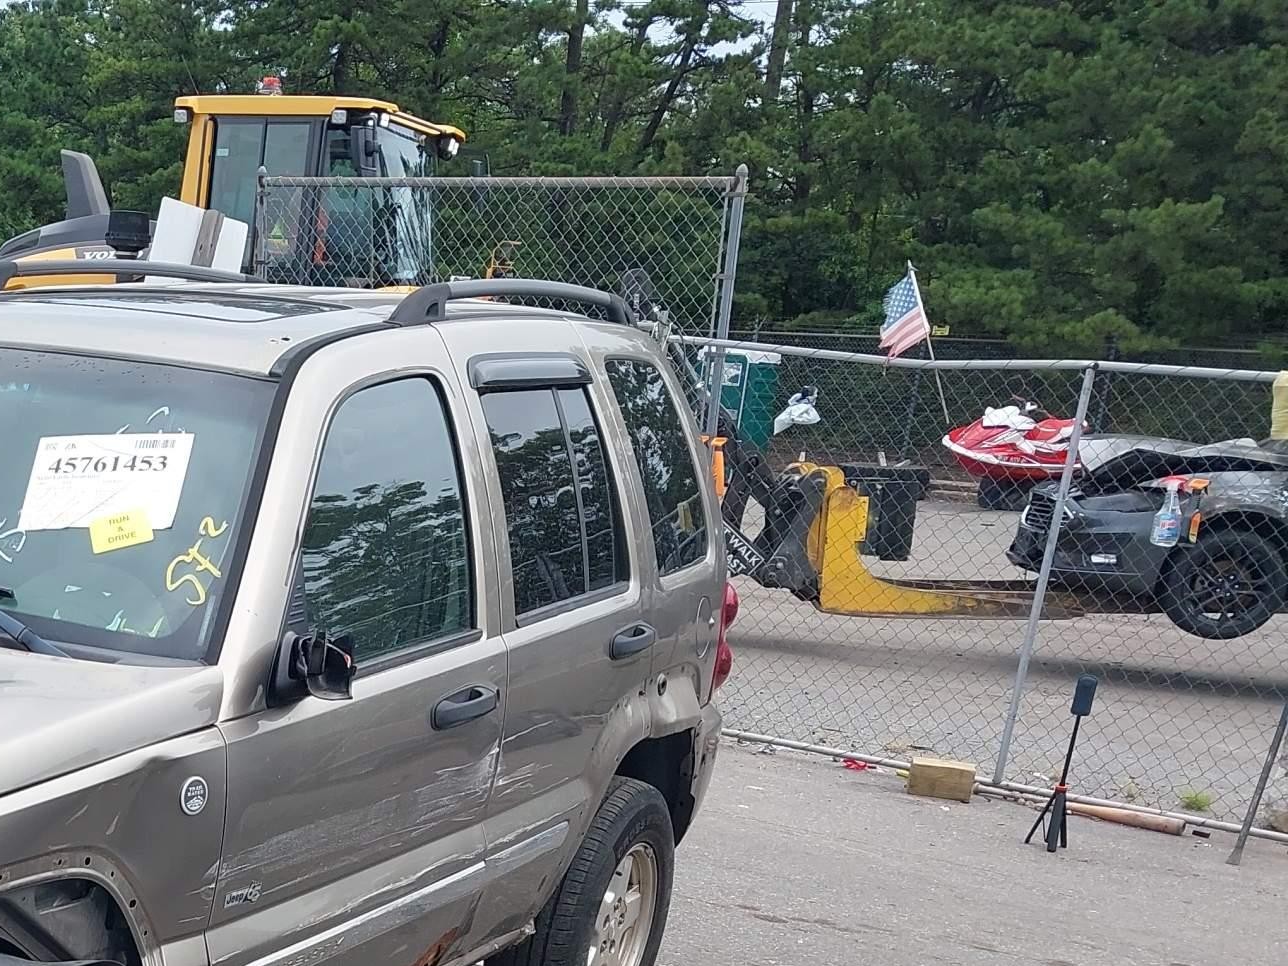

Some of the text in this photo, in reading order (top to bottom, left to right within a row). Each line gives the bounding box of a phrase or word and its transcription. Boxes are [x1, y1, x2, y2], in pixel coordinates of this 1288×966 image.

[48, 455, 168, 474] 45761453
[109, 514, 130, 525] RUN
[108, 531, 136, 544] DRIVE
[729, 534, 760, 567] WALK
[726, 550, 747, 573] AST
